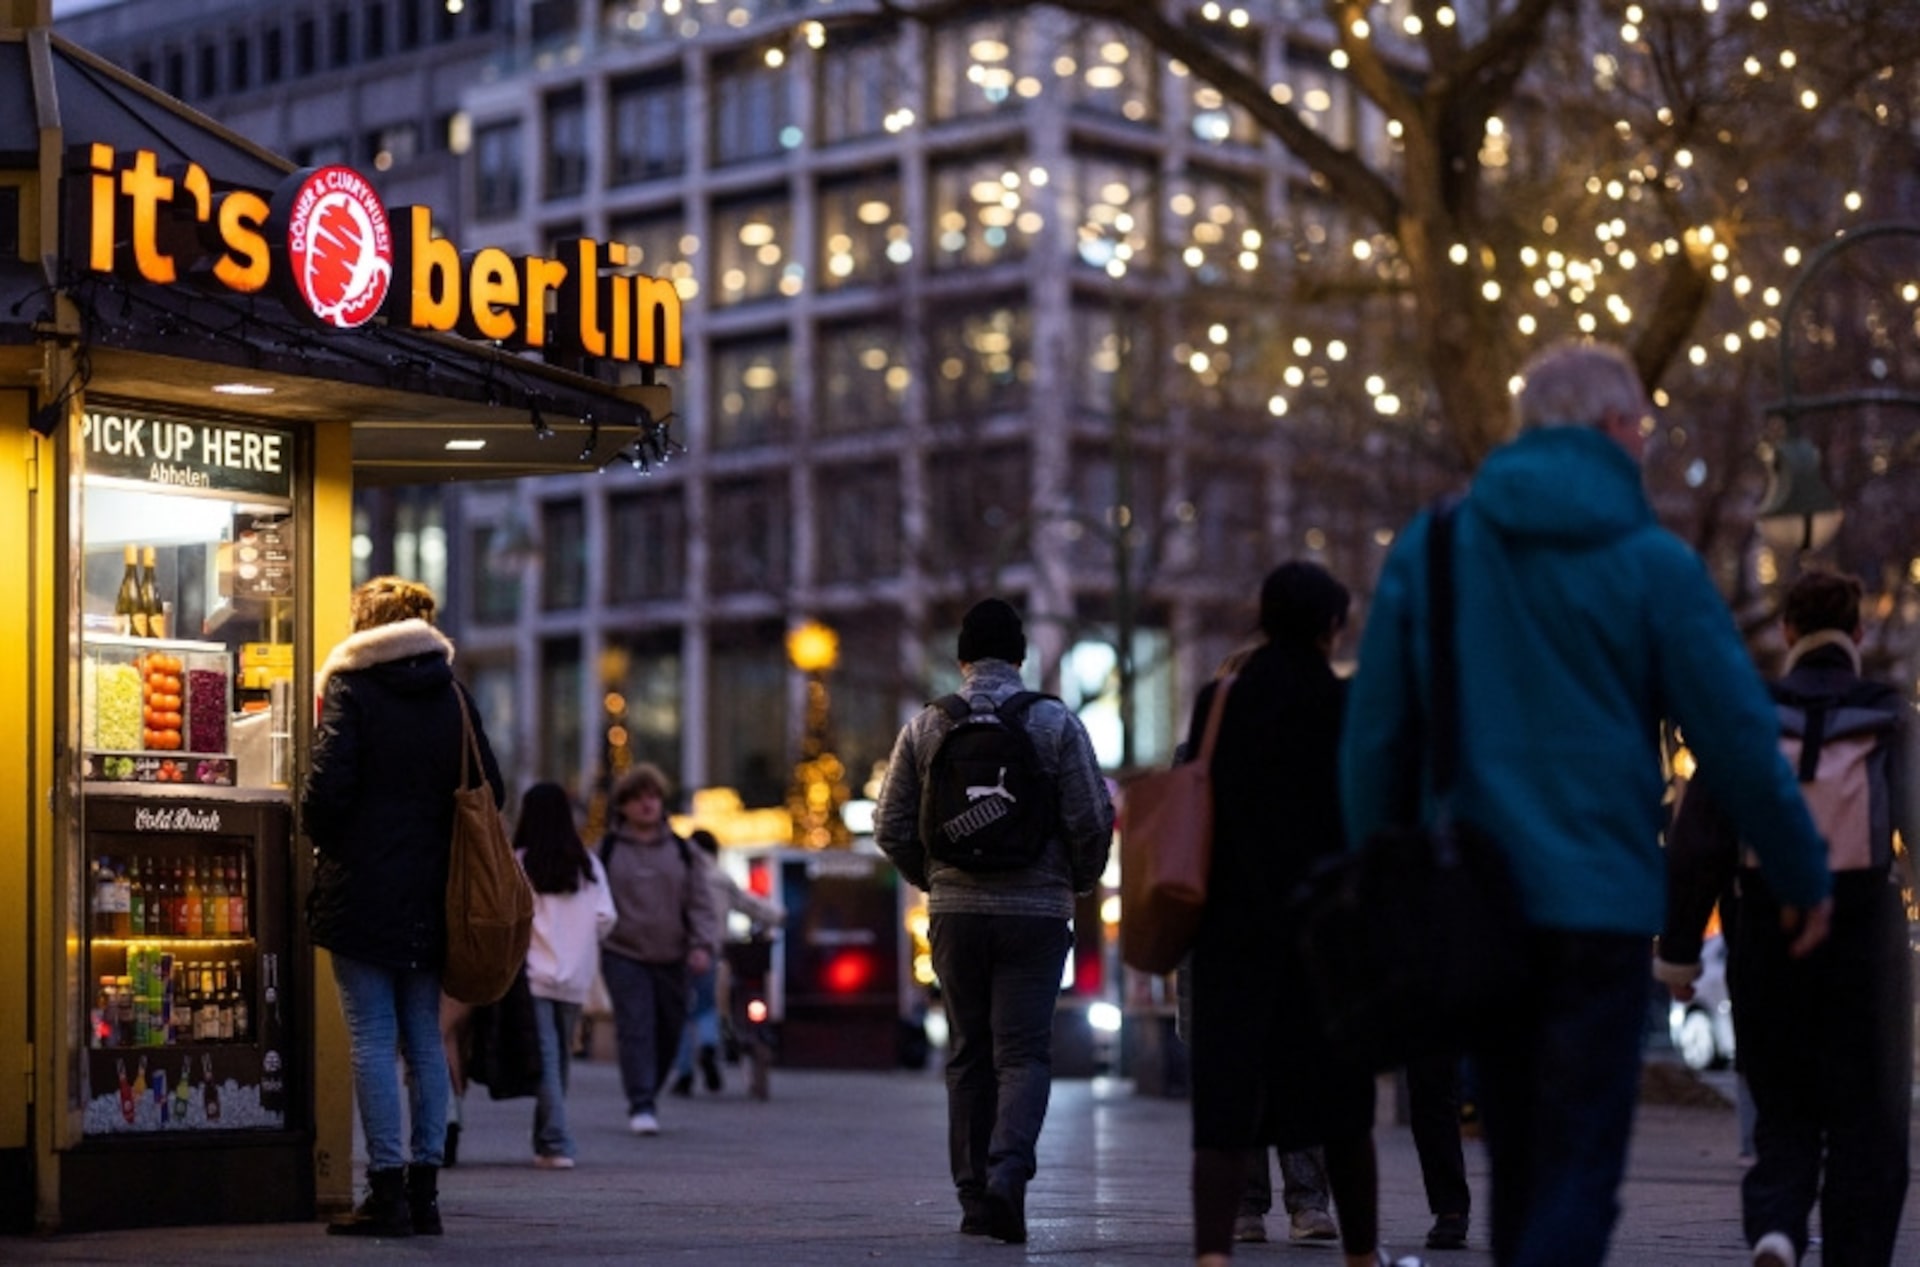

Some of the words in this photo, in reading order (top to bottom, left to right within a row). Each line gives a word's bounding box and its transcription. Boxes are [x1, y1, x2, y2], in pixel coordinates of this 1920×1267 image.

[290, 187, 318, 252] DÖNER
[314, 178, 327, 196] &
[326, 171, 391, 253] CURRYWURST
[90, 142, 271, 293] it's
[411, 204, 683, 368] berlin
[153, 420, 194, 462] UP
[203, 427, 282, 474] HERE
[149, 462, 210, 488] Abholen
[135, 806, 174, 831] Cold
[172, 807, 221, 832] Drink
